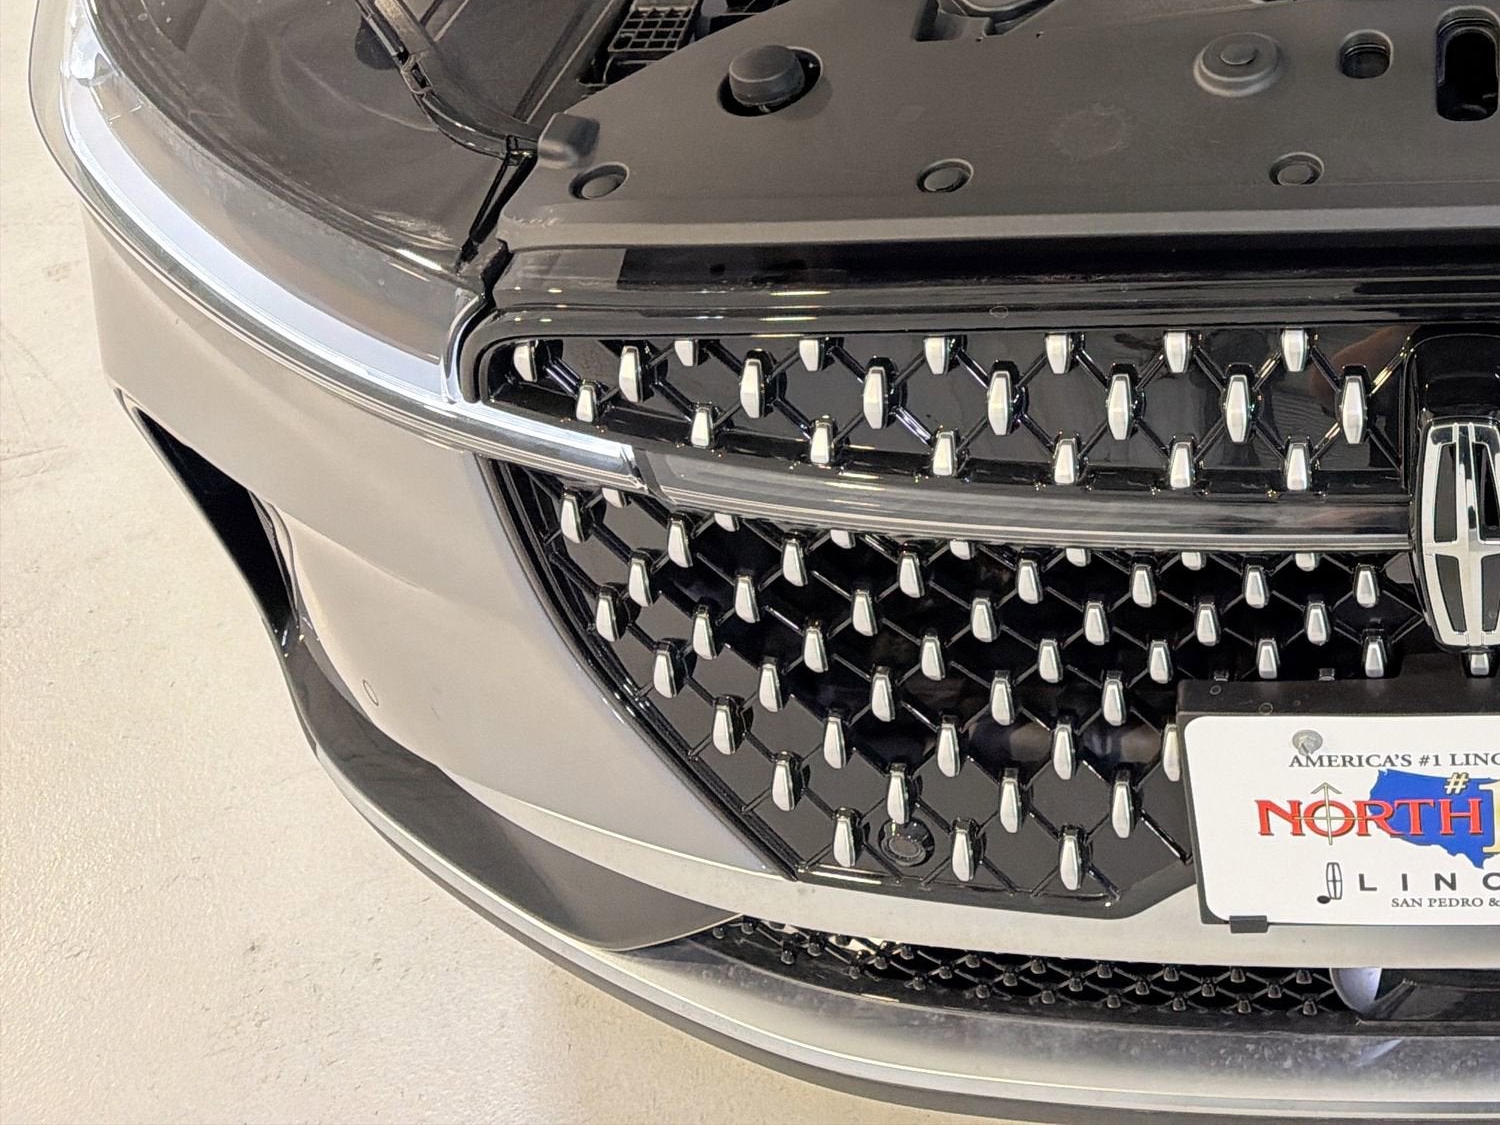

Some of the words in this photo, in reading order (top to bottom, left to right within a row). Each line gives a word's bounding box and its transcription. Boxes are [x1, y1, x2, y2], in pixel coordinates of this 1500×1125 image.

[1288, 753, 1413, 768] AMERICA'S
[1418, 753, 1442, 767] #1
[1254, 796, 1484, 838] NORTH
[1390, 896, 1424, 908] SAN
[1428, 896, 1484, 908] PEDRO
